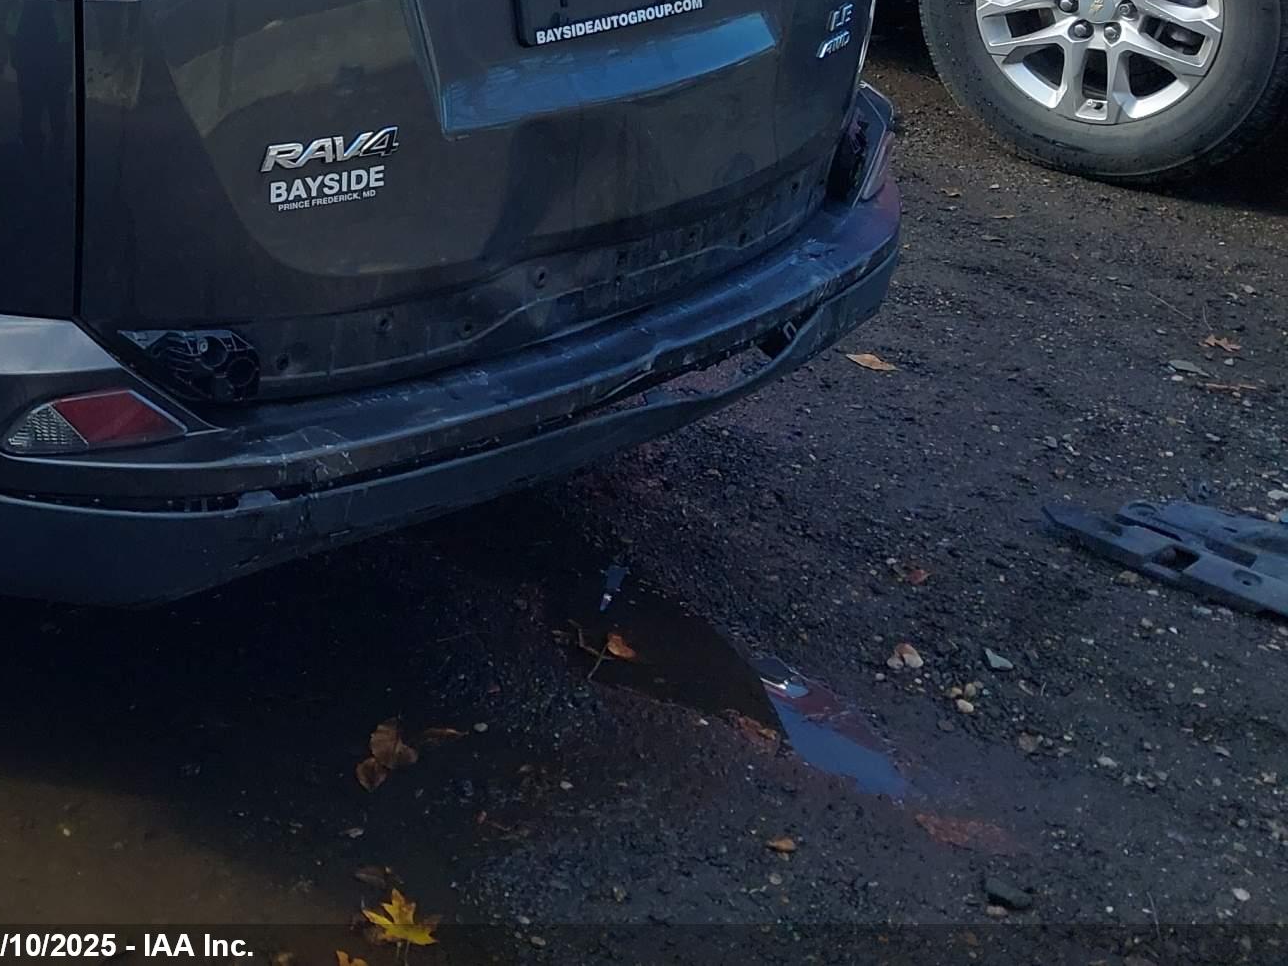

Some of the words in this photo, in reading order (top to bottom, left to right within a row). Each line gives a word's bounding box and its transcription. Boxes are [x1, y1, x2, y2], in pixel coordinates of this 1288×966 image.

[826, 3, 854, 32] LE
[259, 125, 400, 173] RAV4
[269, 165, 385, 204] BAYSIDE
[278, 199, 311, 212] PRINCE
[362, 189, 377, 199] MD
